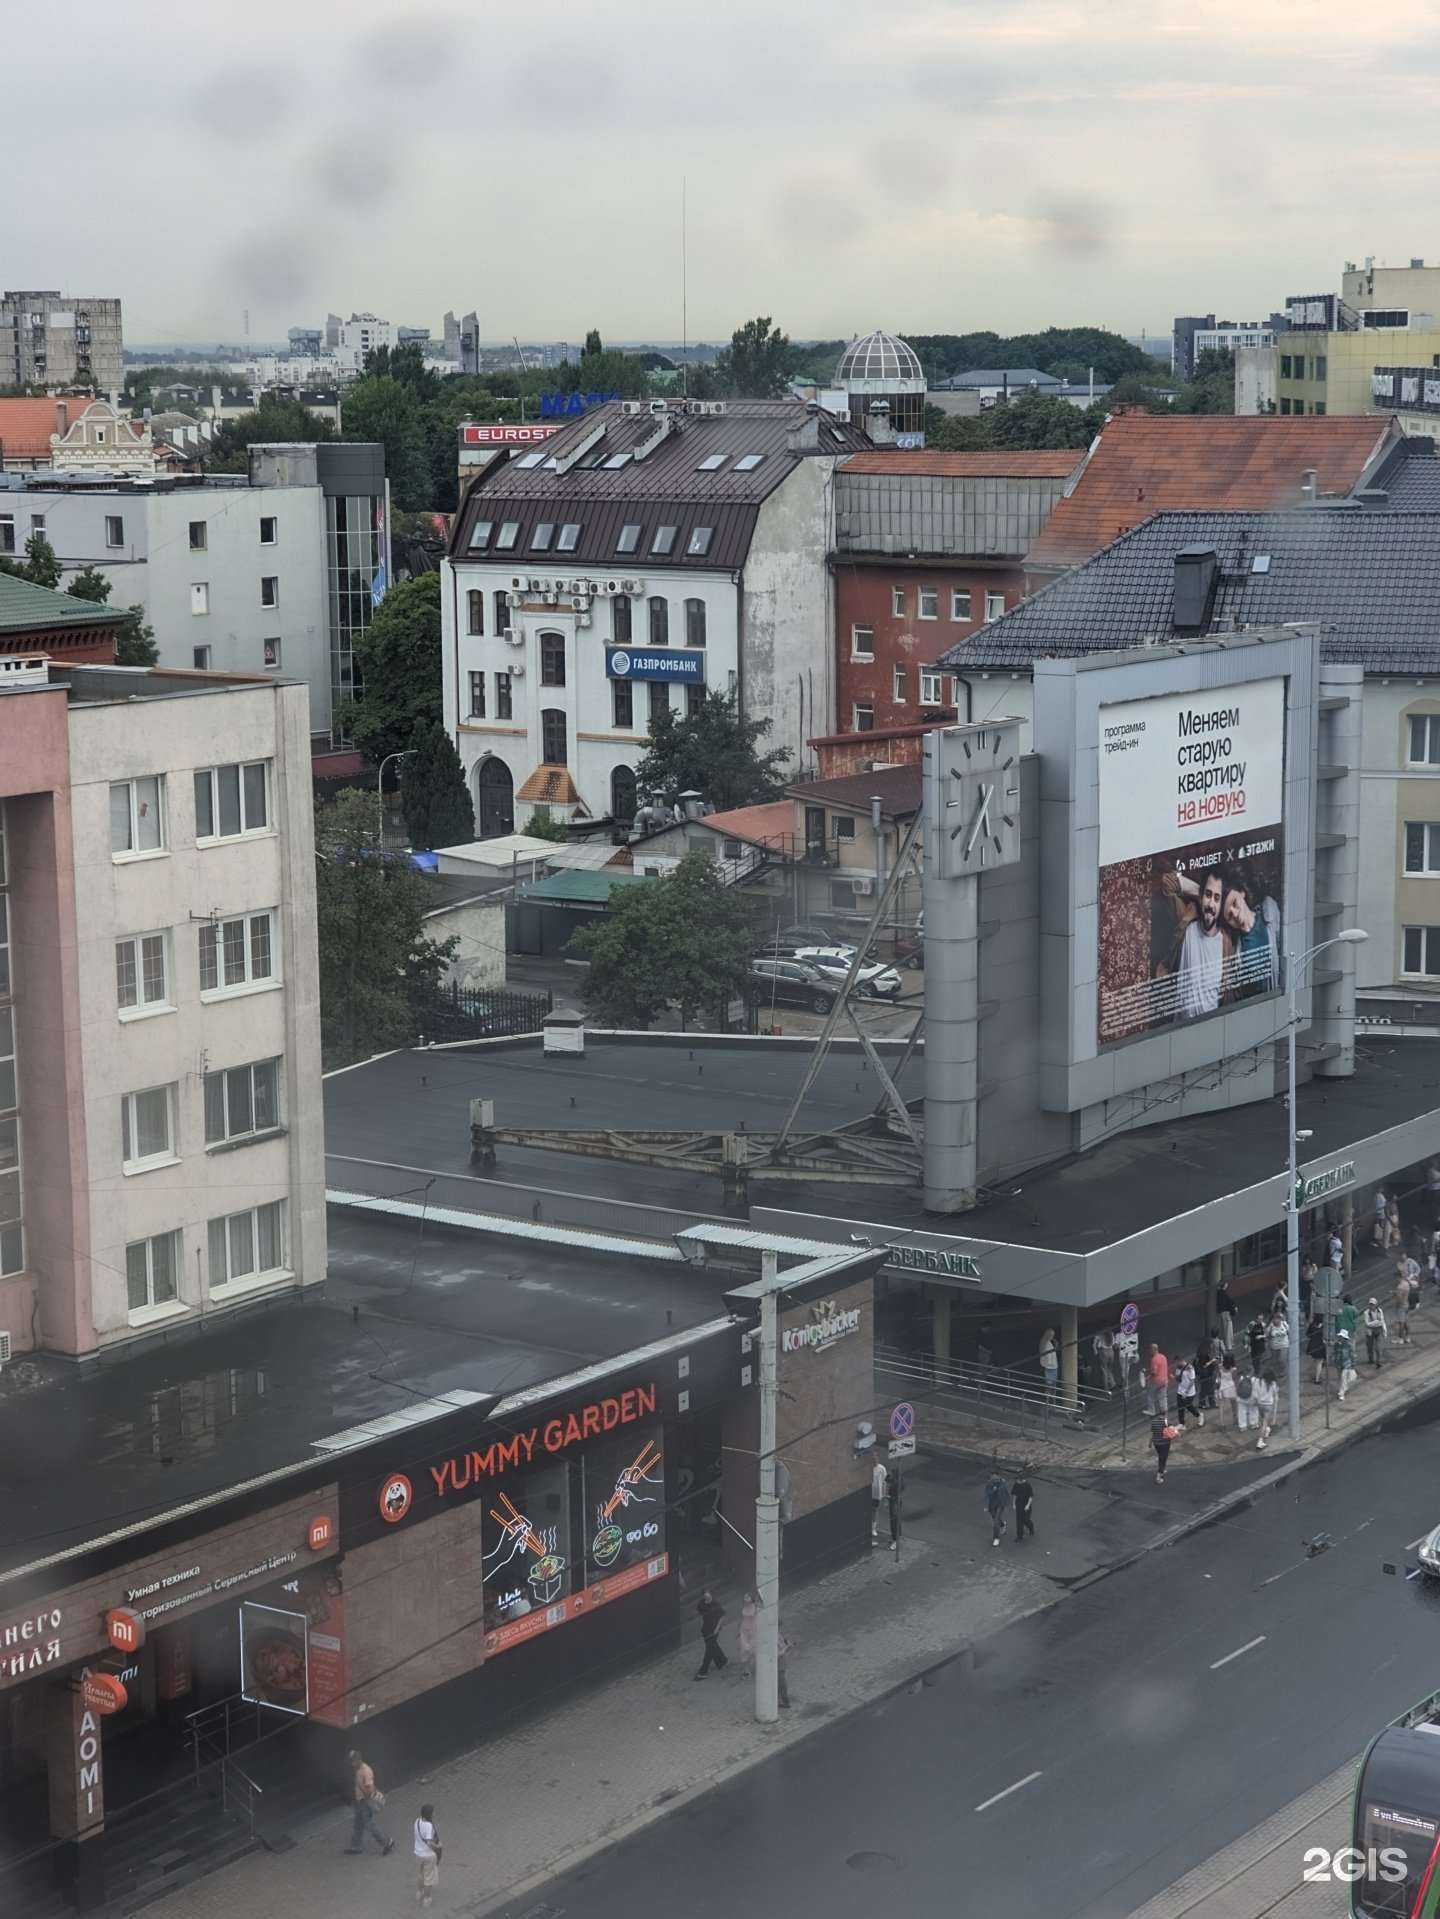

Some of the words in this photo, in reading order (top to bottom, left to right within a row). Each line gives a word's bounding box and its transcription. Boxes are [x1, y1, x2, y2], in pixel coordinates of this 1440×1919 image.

[633, 658, 697, 672] ГАЗПРОМБАНК
[1104, 721, 1146, 739] программа
[1178, 707, 1240, 738] Меняем
[1104, 738, 1139, 755] трейд-ин
[1177, 737, 1232, 767] старую
[1178, 762, 1247, 795] квартиру
[1177, 801, 1196, 823] на
[1198, 790, 1247, 818] новую
[1189, 852, 1223, 871] РАСЦВЕТ
[885, 1243, 981, 1275] БЕРБАНК
[430, 1428, 538, 1497] YUMMY
[544, 1383, 656, 1452] GARDEN
[128, 1582, 160, 1601] Умная
[161, 1566, 200, 1588] техника
[142, 1583, 213, 1620] торизованный
[214, 1560, 268, 1590] Сервисный
[0, 1609, 61, 1647] НЕГО
